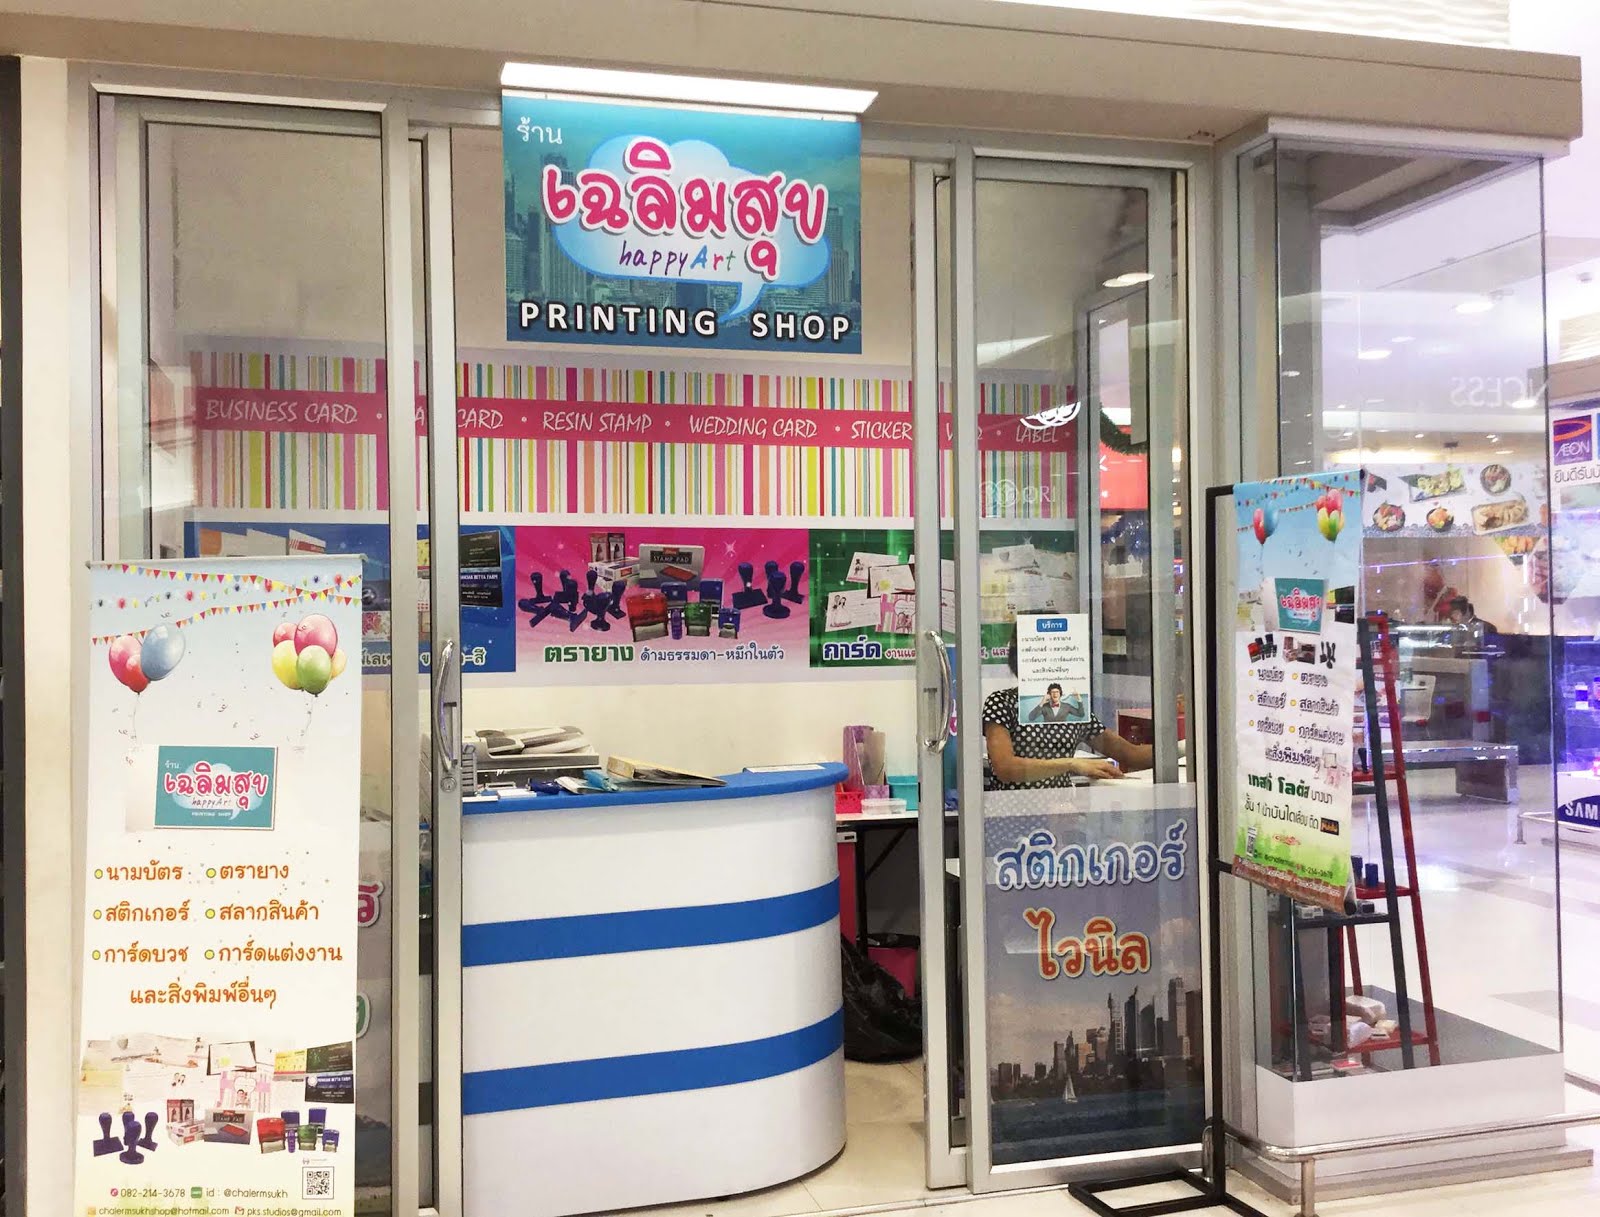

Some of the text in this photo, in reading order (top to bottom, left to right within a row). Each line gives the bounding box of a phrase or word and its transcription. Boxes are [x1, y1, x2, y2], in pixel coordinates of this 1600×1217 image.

[516, 116, 562, 144] ร้าน
[544, 139, 826, 278] เฉลิมสุข
[520, 301, 850, 341] PRINTING SHOP
[205, 399, 298, 422] BUSINESS
[304, 402, 359, 424] CARD
[542, 411, 594, 431] RESIN
[599, 412, 652, 433] STAMP
[688, 415, 767, 437] WEDDING
[773, 418, 818, 438] CARD
[851, 420, 912, 440] STICKER
[1042, 621, 1063, 629] บริการ
[544, 645, 635, 663] ตรายาง
[824, 635, 881, 660] การ์ด
[164, 761, 268, 811] เฉลิมสุข
[996, 820, 1187, 889] สติกเกอร์
[107, 859, 289, 880] นามบัตร ตรายาง
[105, 899, 319, 922] สติกเกอร์ สลากสินค้า
[104, 939, 342, 963] การ์ดบวช การ์ดแต่งงาน
[1025, 908, 1150, 978] ไวนิล
[130, 976, 277, 1009] และสิ่งพิมพ์อื่นๆ
[120, 1188, 185, 1198] 082-214-3678
[206, 1188, 215, 1197] id
[224, 1189, 288, 1199] @chalermsukh
[99, 1206, 229, 1217] chalermsukhshop@hotmail.com
